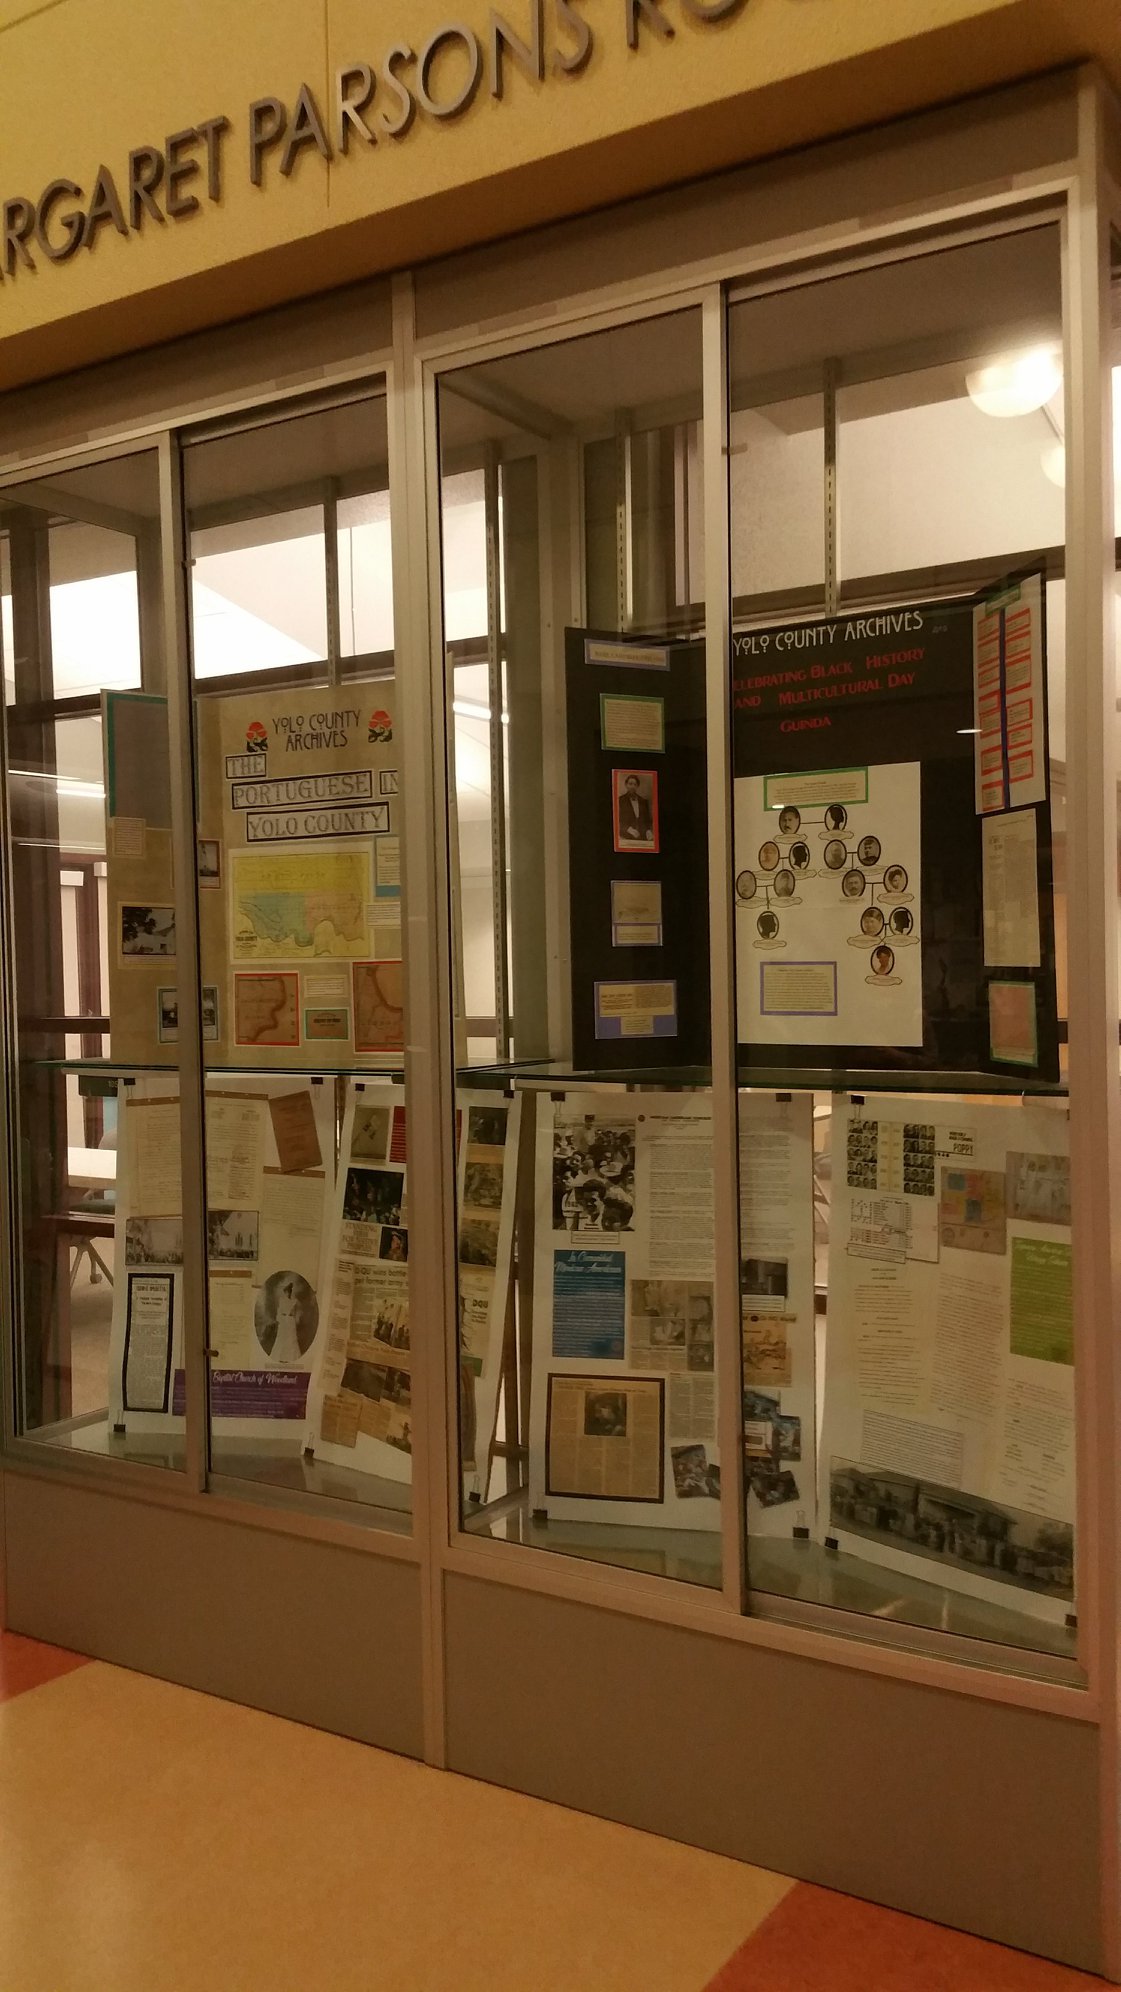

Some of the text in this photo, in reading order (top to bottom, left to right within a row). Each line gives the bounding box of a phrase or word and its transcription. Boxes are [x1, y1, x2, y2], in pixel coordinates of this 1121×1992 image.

[0, 0, 593, 280] RGARET PARSONS
[733, 635, 769, 656] YOLO
[775, 624, 837, 651] COUNTY
[845, 610, 924, 641] ARCHIVES
[733, 647, 926, 692] ELEBRATING BLACK HISTORY
[734, 672, 916, 709] AND MULTICULTURAL DAY
[272, 709, 362, 735] YOLO COUNTY
[779, 715, 832, 733] GUINDA
[286, 730, 348, 752] ARCHIVES
[228, 755, 264, 776] THE
[234, 773, 368, 806] PORTUGUESE
[249, 806, 385, 839] YOLO COUNTY
